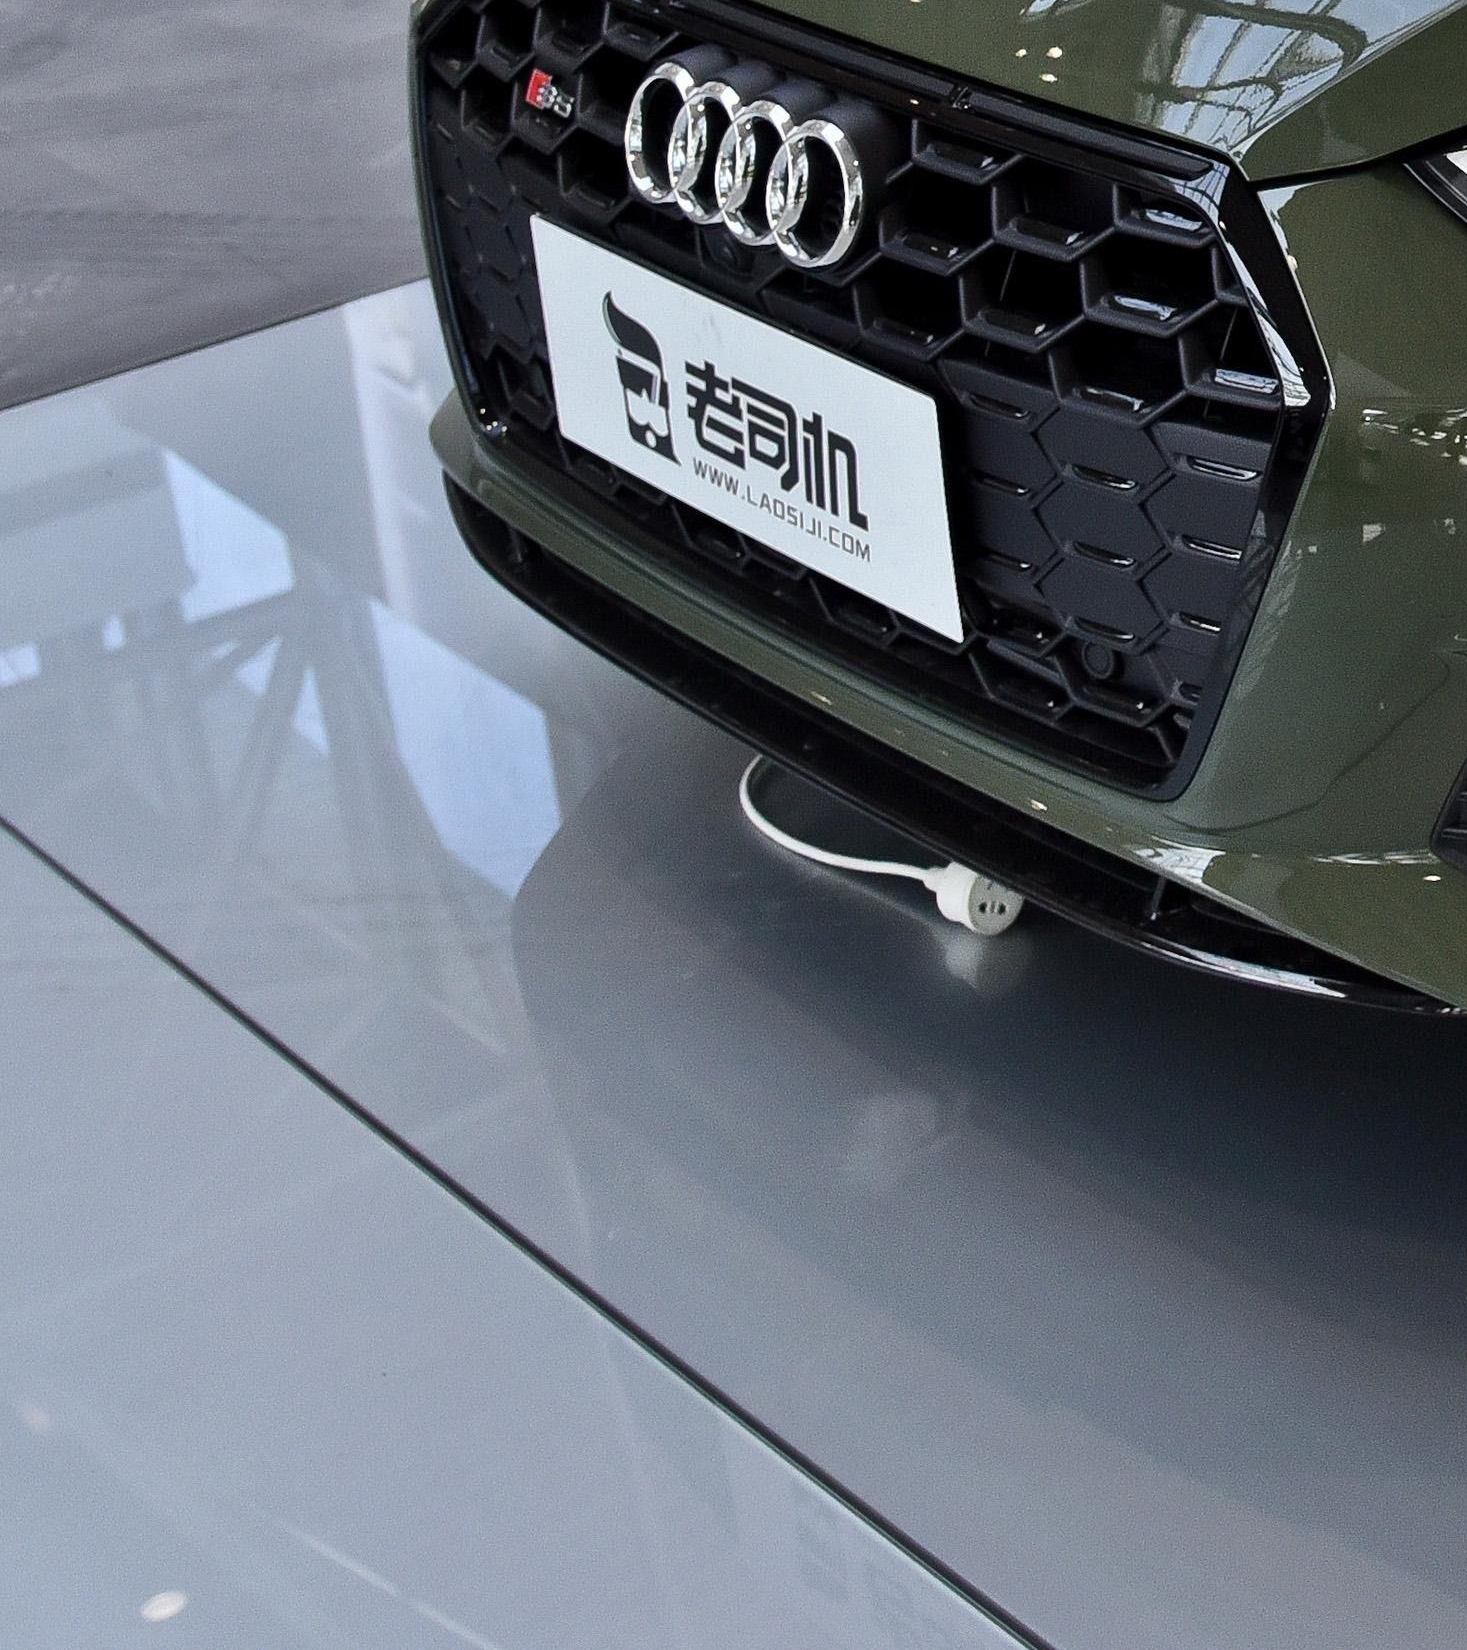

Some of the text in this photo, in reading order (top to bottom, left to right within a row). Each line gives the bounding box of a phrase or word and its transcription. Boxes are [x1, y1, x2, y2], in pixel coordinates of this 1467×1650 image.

[685, 359, 869, 532] 老司机
[692, 457, 871, 563] WWW.LAOSIJI.COM
